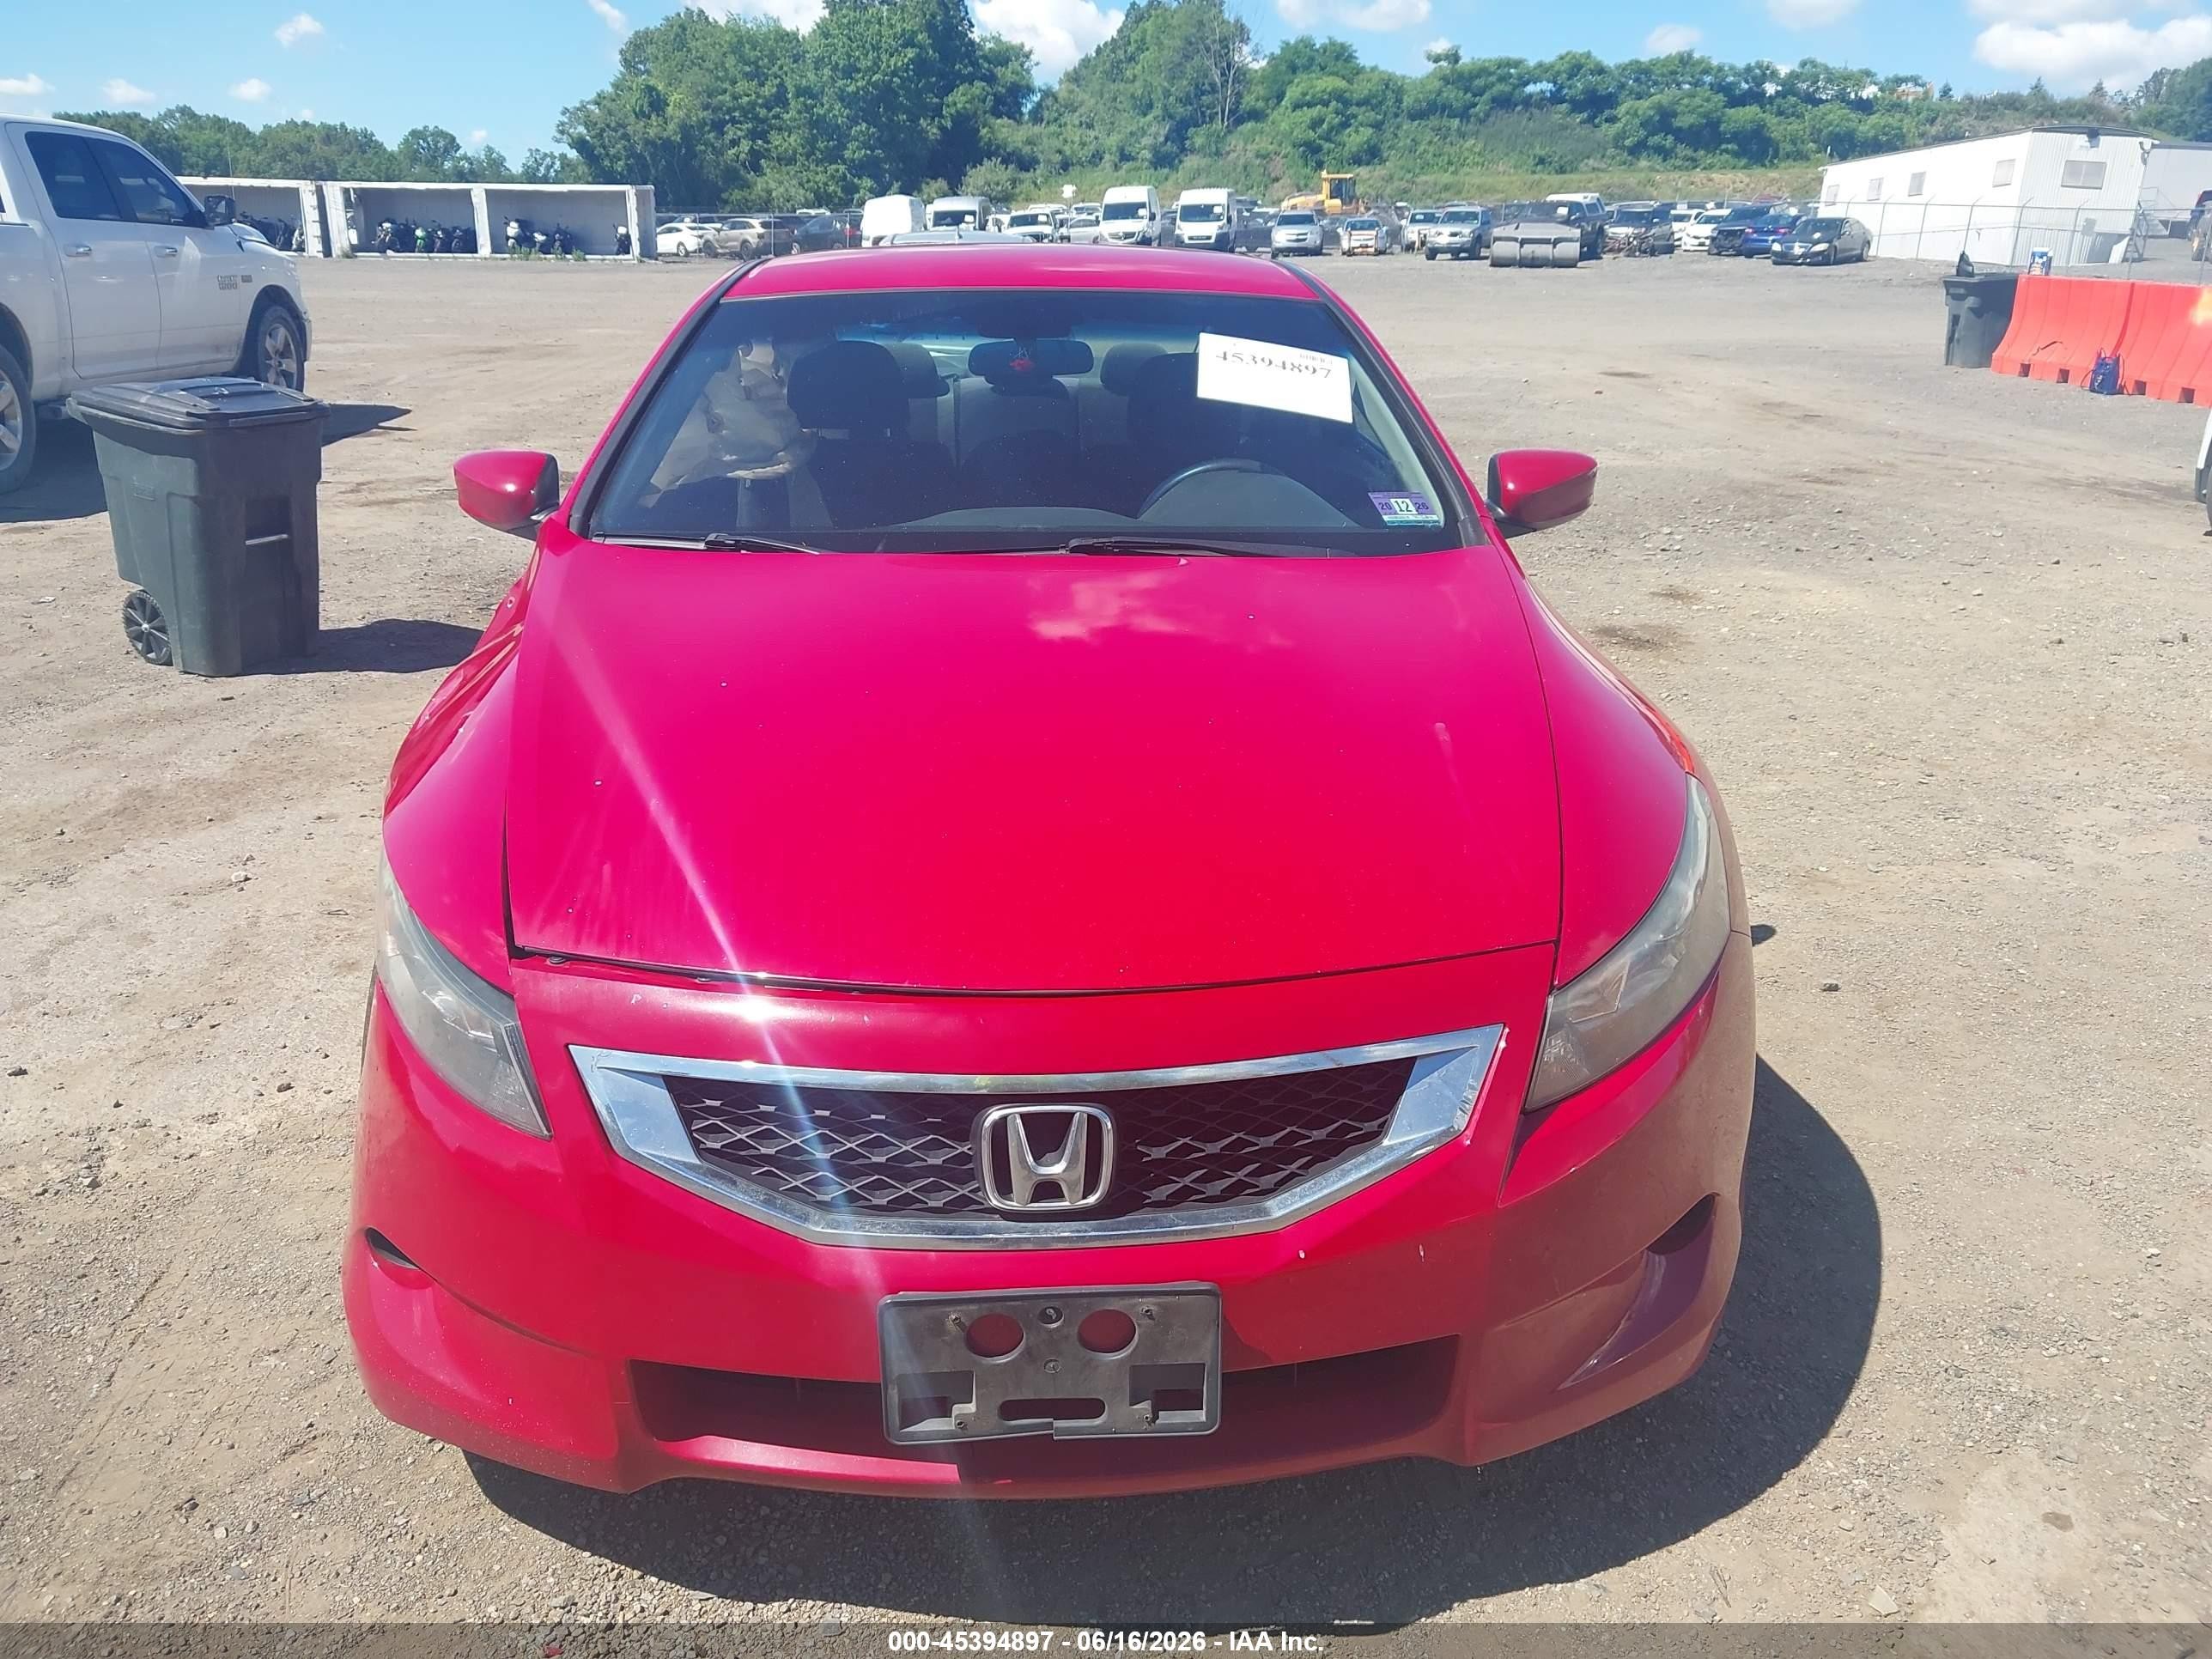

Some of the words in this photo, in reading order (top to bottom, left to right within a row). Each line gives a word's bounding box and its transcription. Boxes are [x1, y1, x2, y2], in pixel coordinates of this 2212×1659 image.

[1216, 350, 1332, 379] 45394897
[1378, 501, 1392, 510] 20
[1395, 500, 1413, 513] 12
